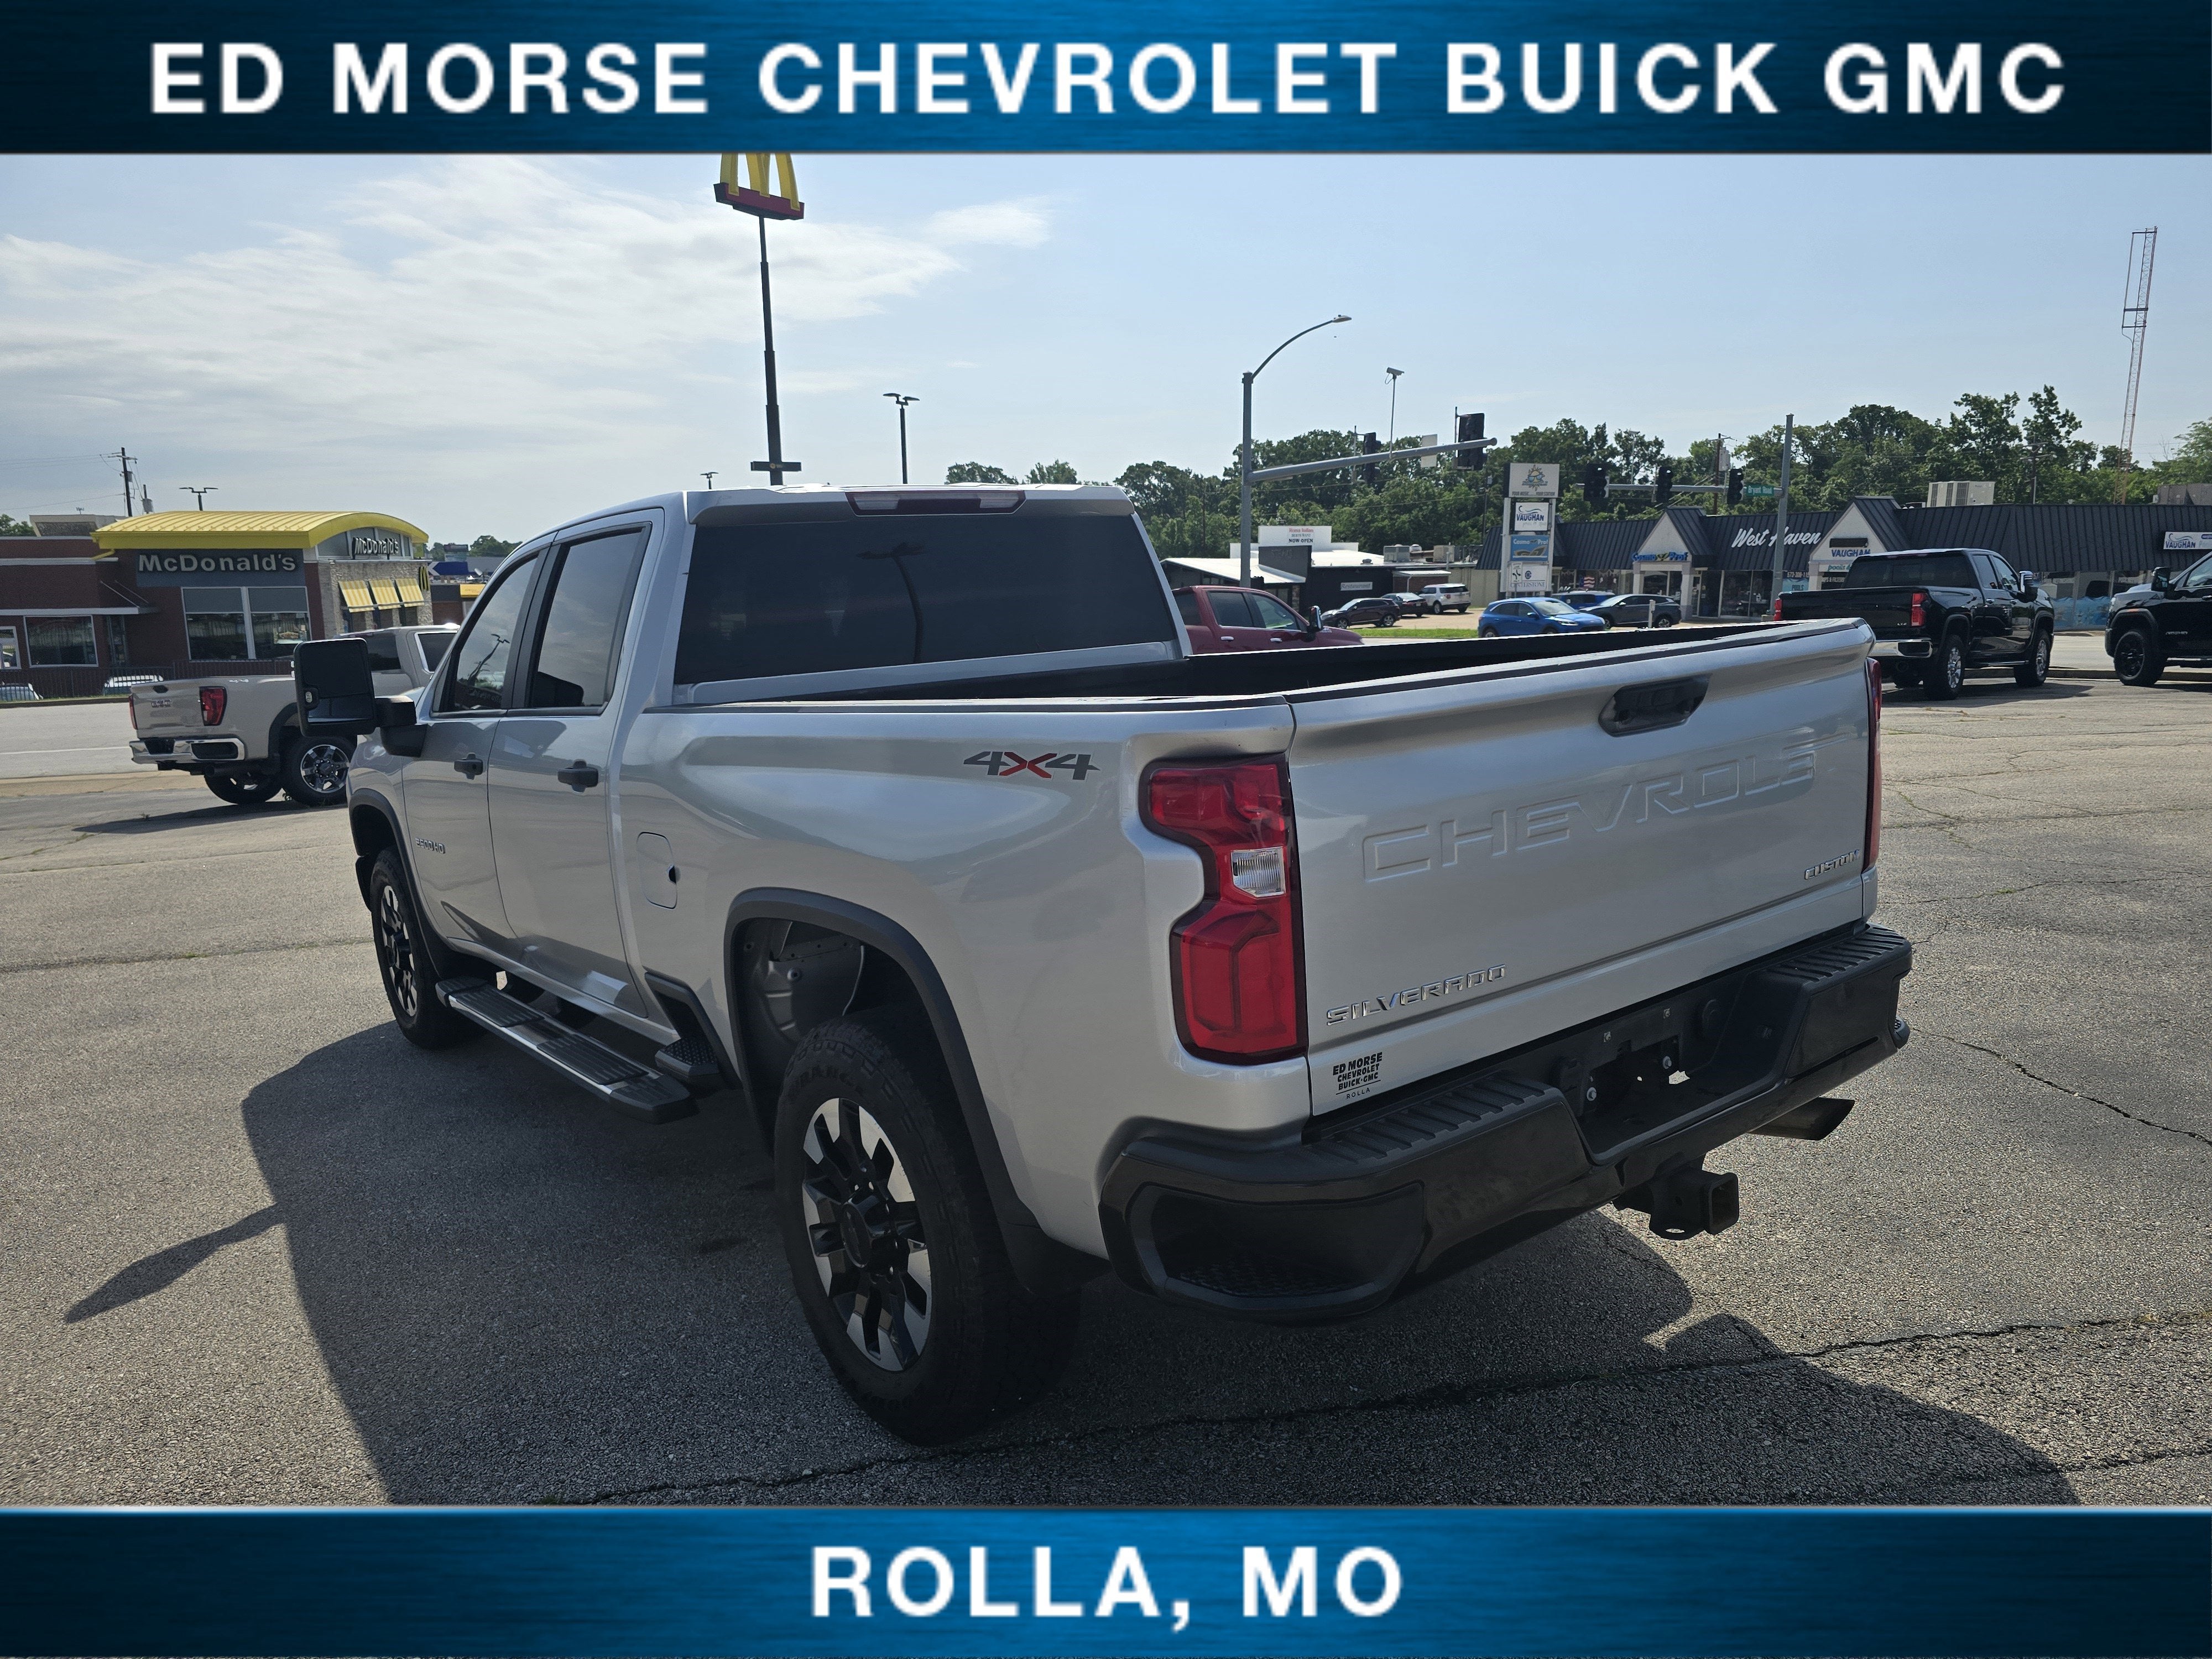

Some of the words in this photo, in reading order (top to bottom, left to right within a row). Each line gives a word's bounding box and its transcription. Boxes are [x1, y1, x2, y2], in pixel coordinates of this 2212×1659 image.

[354, 538, 398, 554] McDonald's
[1731, 528, 1770, 548] West
[1831, 549, 1871, 557] VAUGHAN
[139, 554, 296, 571] McDonald's
[1327, 964, 1506, 1026] SILVERADO
[1333, 1063, 1346, 1076] ED
[1348, 1052, 1383, 1071] MORSE
[1337, 1063, 1380, 1082] CHEVROLET
[1346, 1087, 1370, 1099] ROLLA
